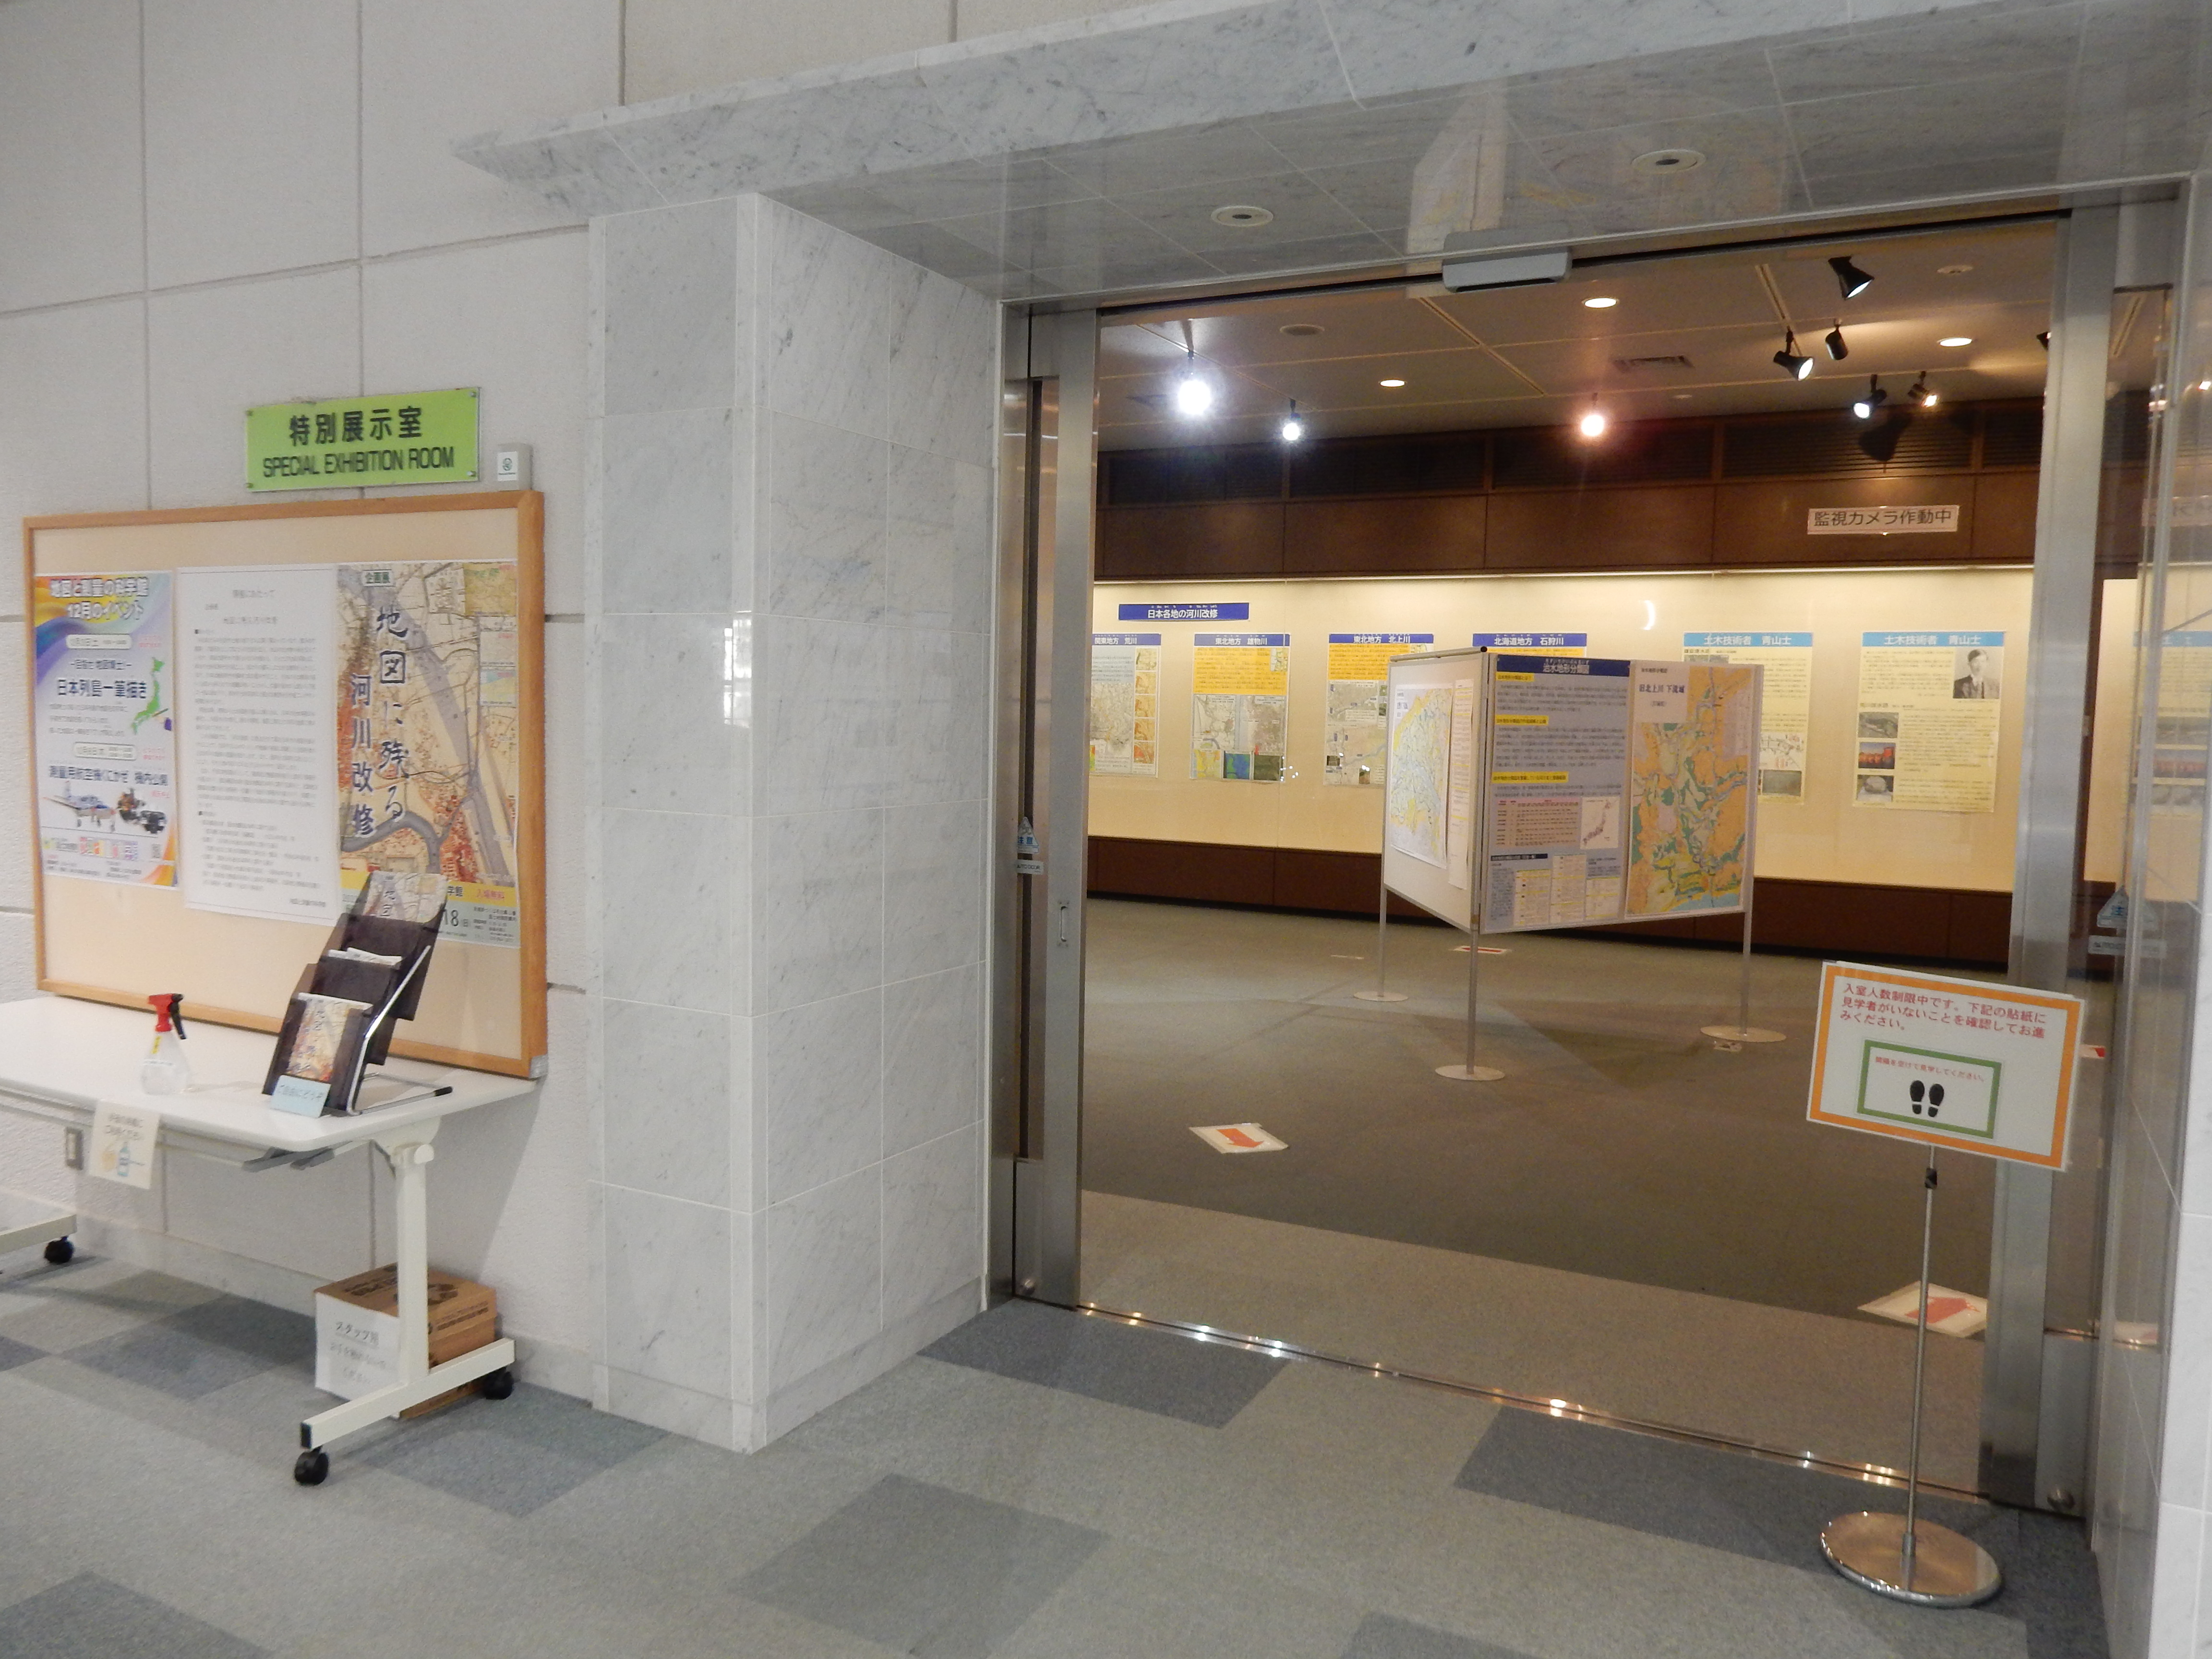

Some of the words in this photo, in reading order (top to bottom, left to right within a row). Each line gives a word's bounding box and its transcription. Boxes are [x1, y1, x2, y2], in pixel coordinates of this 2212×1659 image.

[290, 406, 422, 446] 特別展示室
[263, 455, 320, 477] SPECIAL
[325, 449, 404, 473] EXHIBITION
[408, 446, 454, 469] ROOM
[1814, 509, 1952, 527] 監視カメラ作動中
[1148, 609, 1218, 619] 日本各地の河川改修
[1094, 637, 1119, 645] 関東地方
[1124, 637, 1138, 645] 荒川
[1215, 637, 1242, 646] 東北地方
[1247, 637, 1268, 646] 雄物川
[1354, 635, 1382, 644] 東北地方
[1388, 635, 1411, 644] 北上川
[1494, 637, 1533, 646] 北海道地方
[1540, 637, 1564, 646] 石狩川
[1704, 636, 1752, 646] 土木技術者
[1884, 635, 1938, 646] 土木技術者
[351, 673, 374, 836] 河川改修
[1840, 1010, 1906, 1031] みください。
[1842, 996, 2045, 1039] 見学者がいないことを確認してお進
